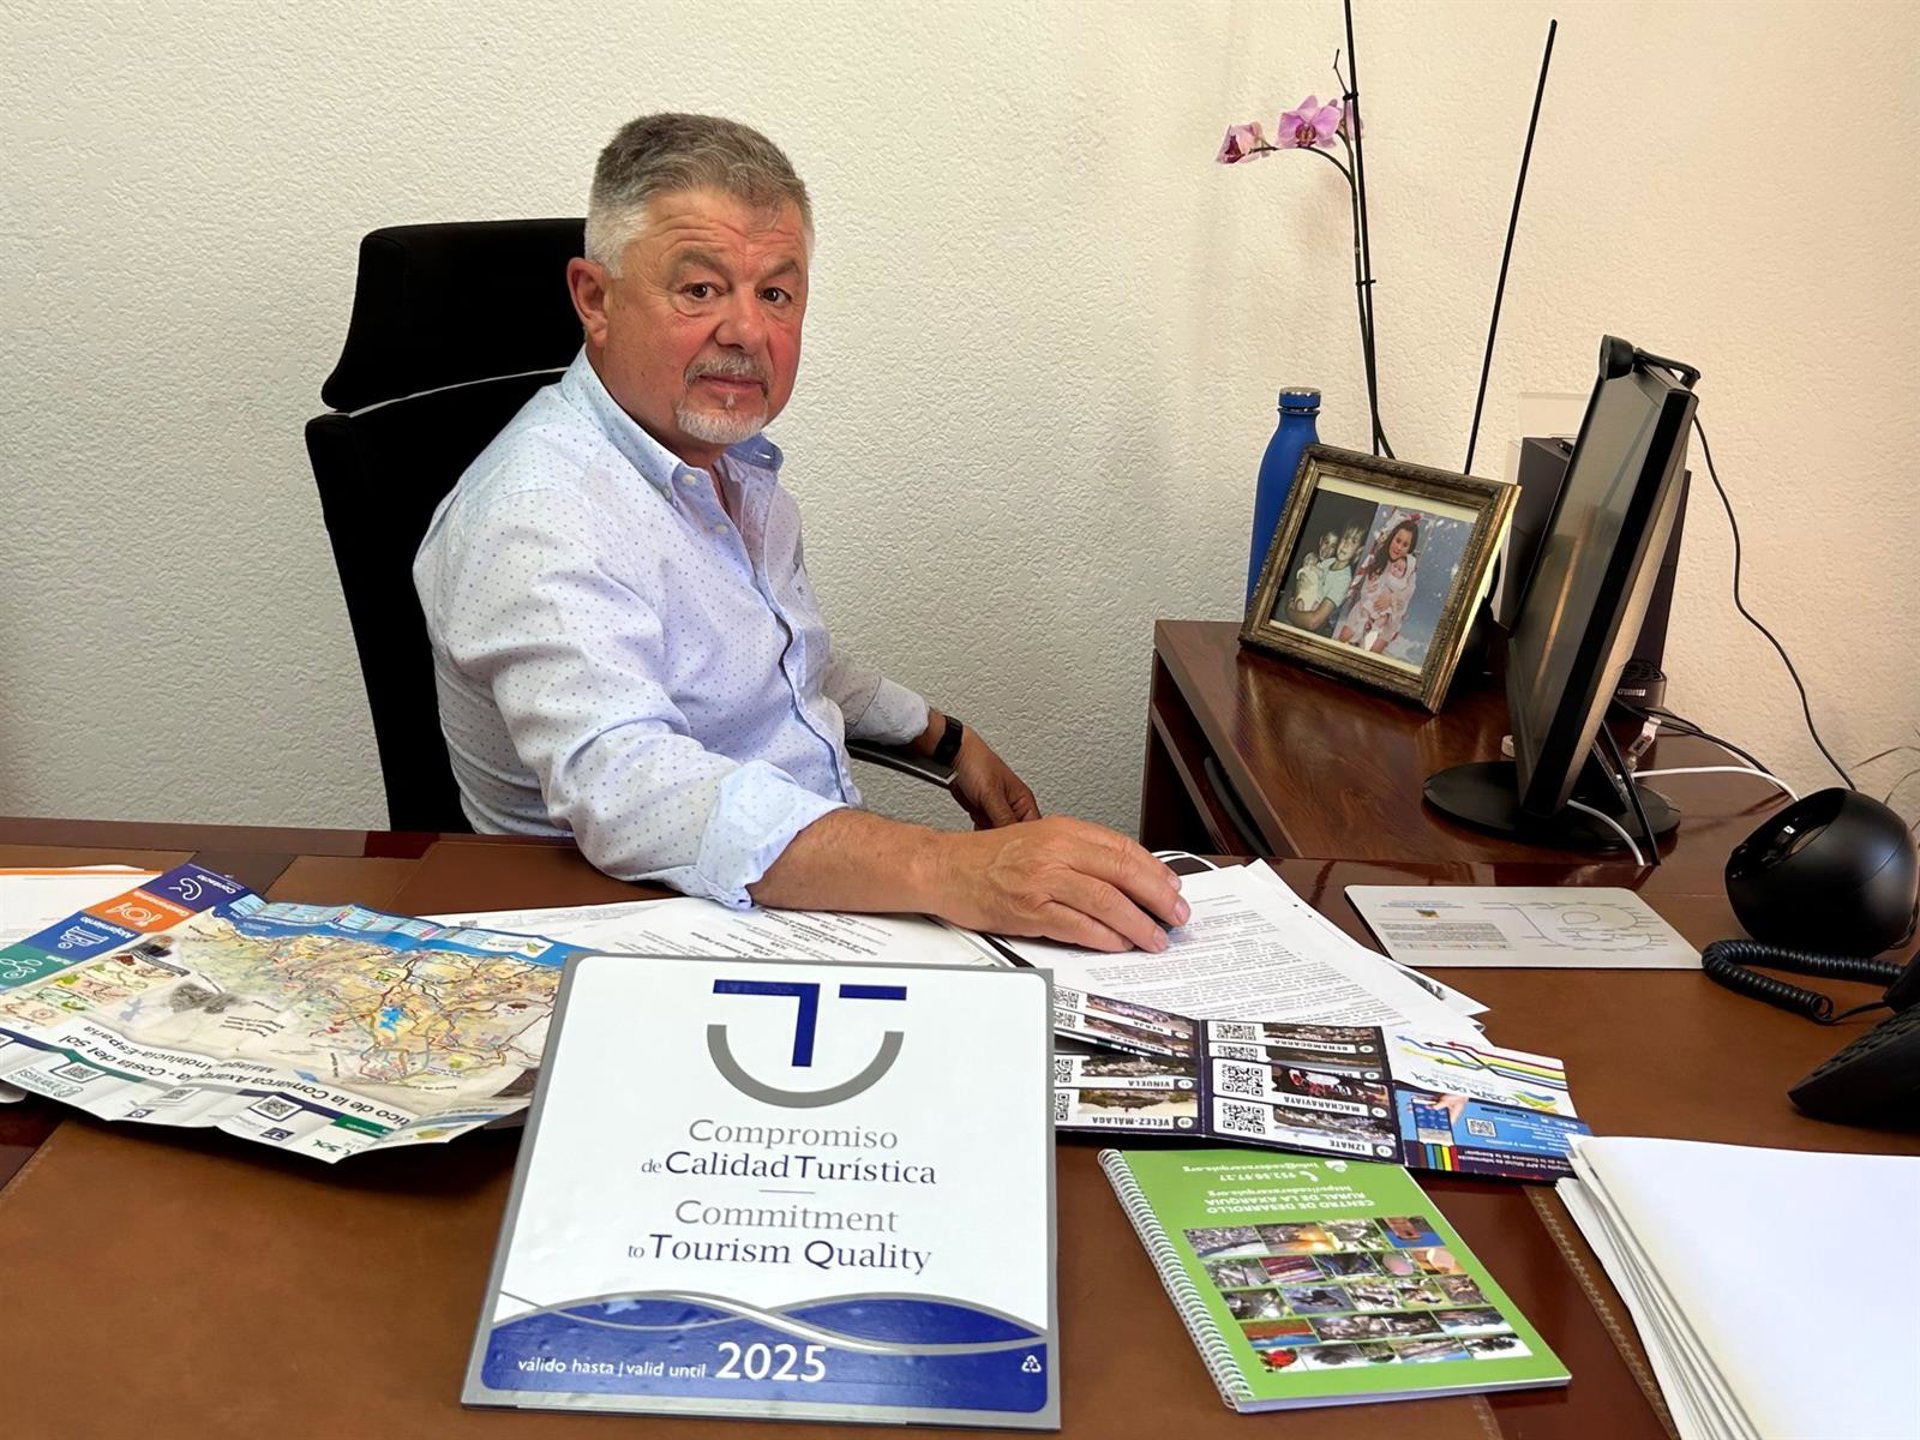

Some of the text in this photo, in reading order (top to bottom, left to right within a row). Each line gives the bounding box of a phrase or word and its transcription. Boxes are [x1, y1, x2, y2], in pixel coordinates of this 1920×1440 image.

[79, 916, 135, 939] Alojamiento
[1274, 1039, 1348, 1051] BENAMOCARRA
[86, 1047, 117, 1062] del
[117, 1060, 166, 1076] Costa
[251, 1077, 329, 1100] Comarca
[332, 1095, 349, 1106] la
[350, 1102, 374, 1113] de
[1283, 1095, 1360, 1113] MACHARAVIAYA
[1092, 1116, 1170, 1127] VÉLEZ-MÁLAGA
[689, 1118, 899, 1150] Compromiso
[1329, 1139, 1365, 1153] IZNATE
[641, 1151, 937, 1185] de Calidad Turística
[1280, 1195, 1298, 1204] LA
[1300, 1193, 1319, 1204] DE
[1321, 1191, 1366, 1202] RURAL
[1206, 1199, 1376, 1215] CENTRO DE DESARROLLO
[675, 1199, 900, 1233] Commitment
[628, 1233, 932, 1276] to Tourism Quality
[517, 1341, 827, 1383] válido hasta valid until 2025
